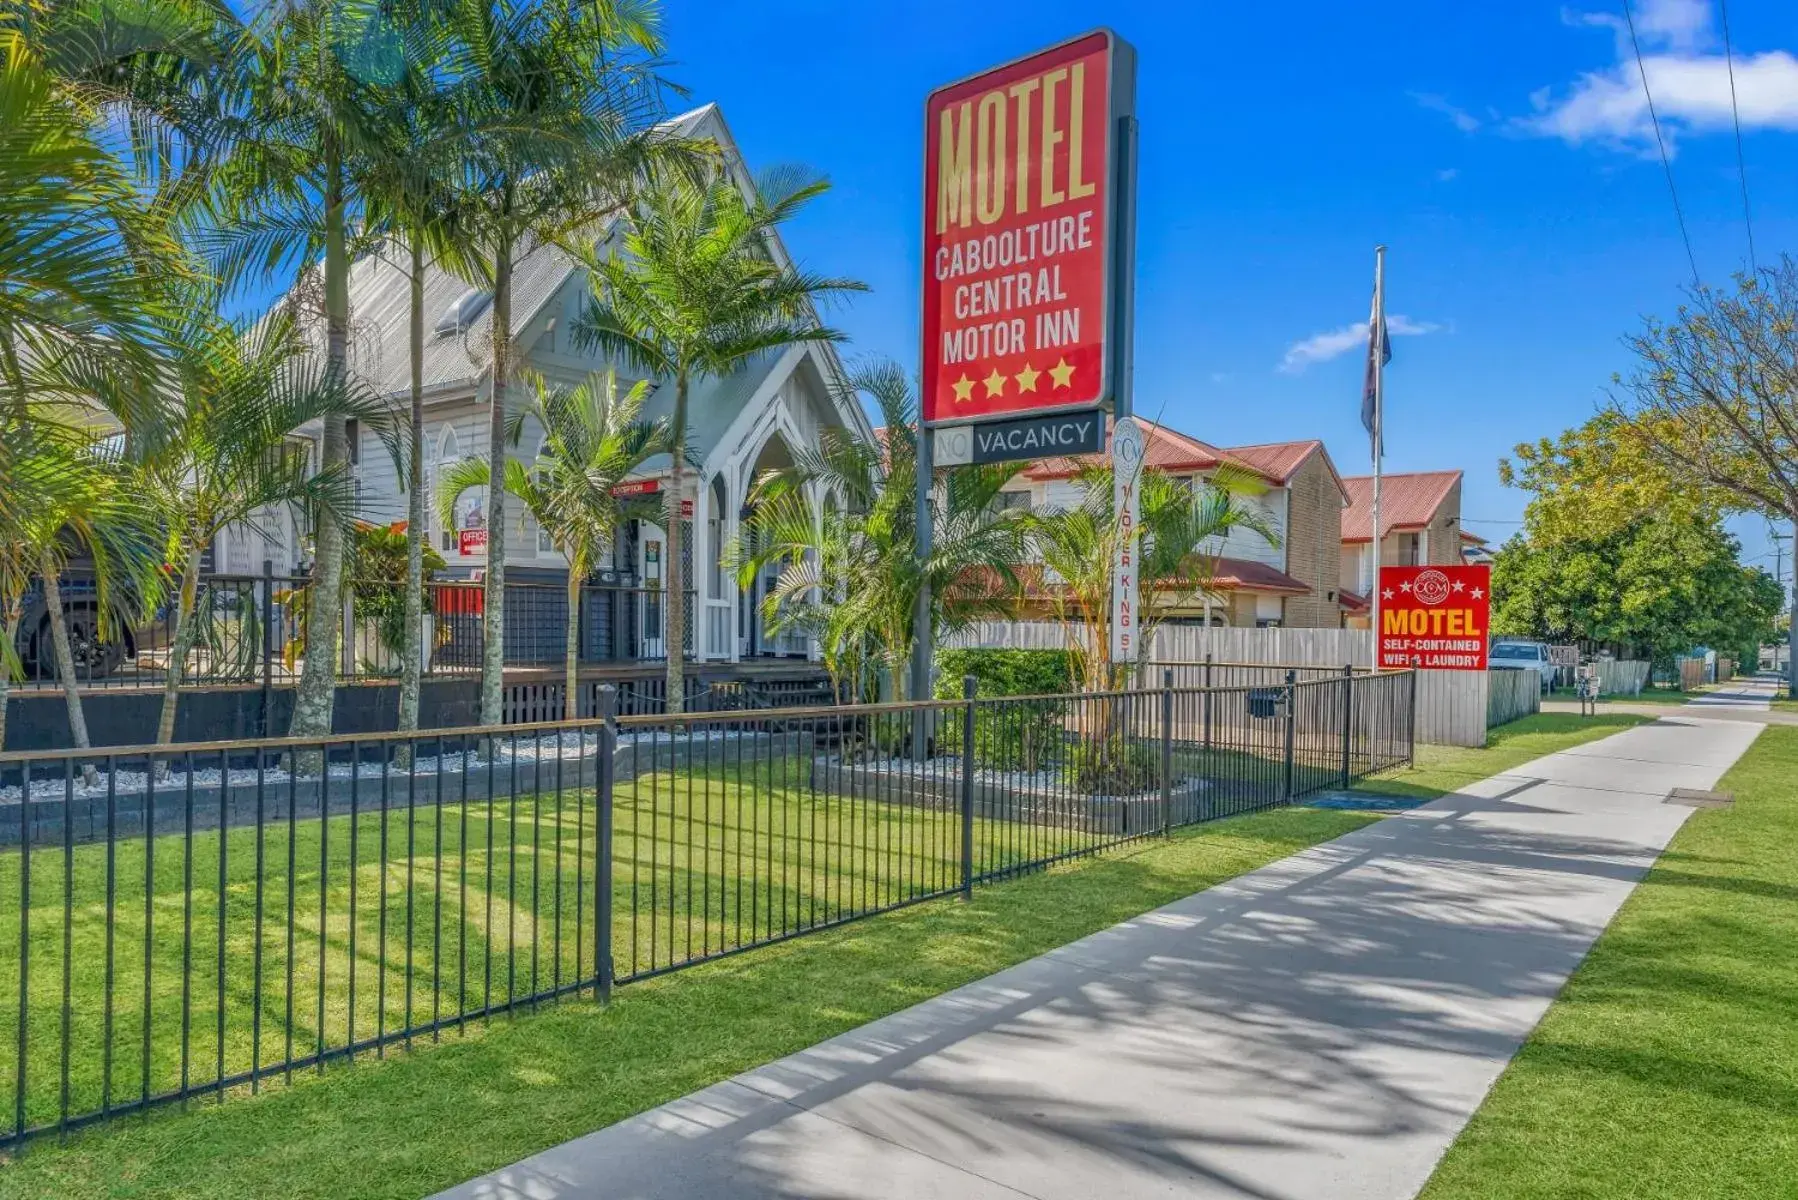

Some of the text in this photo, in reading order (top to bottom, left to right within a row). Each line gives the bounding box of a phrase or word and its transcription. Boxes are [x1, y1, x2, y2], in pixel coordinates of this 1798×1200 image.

[936, 62, 1096, 235] MOTEL
[935, 210, 1093, 281] CABOOLTURE
[954, 264, 1067, 320] CENTRAL
[943, 307, 1081, 365] MOTOR INN
[936, 433, 967, 459] NO
[978, 421, 1092, 453] VACANCY
[462, 531, 488, 542] OFFICE
[1121, 575, 1130, 627] KING
[1384, 608, 1480, 635] MOTEL
[1384, 639, 1480, 652] SELF-CONTAINED
[1384, 654, 1410, 665] WIFI
[1425, 654, 1480, 667] LAUNDRY
